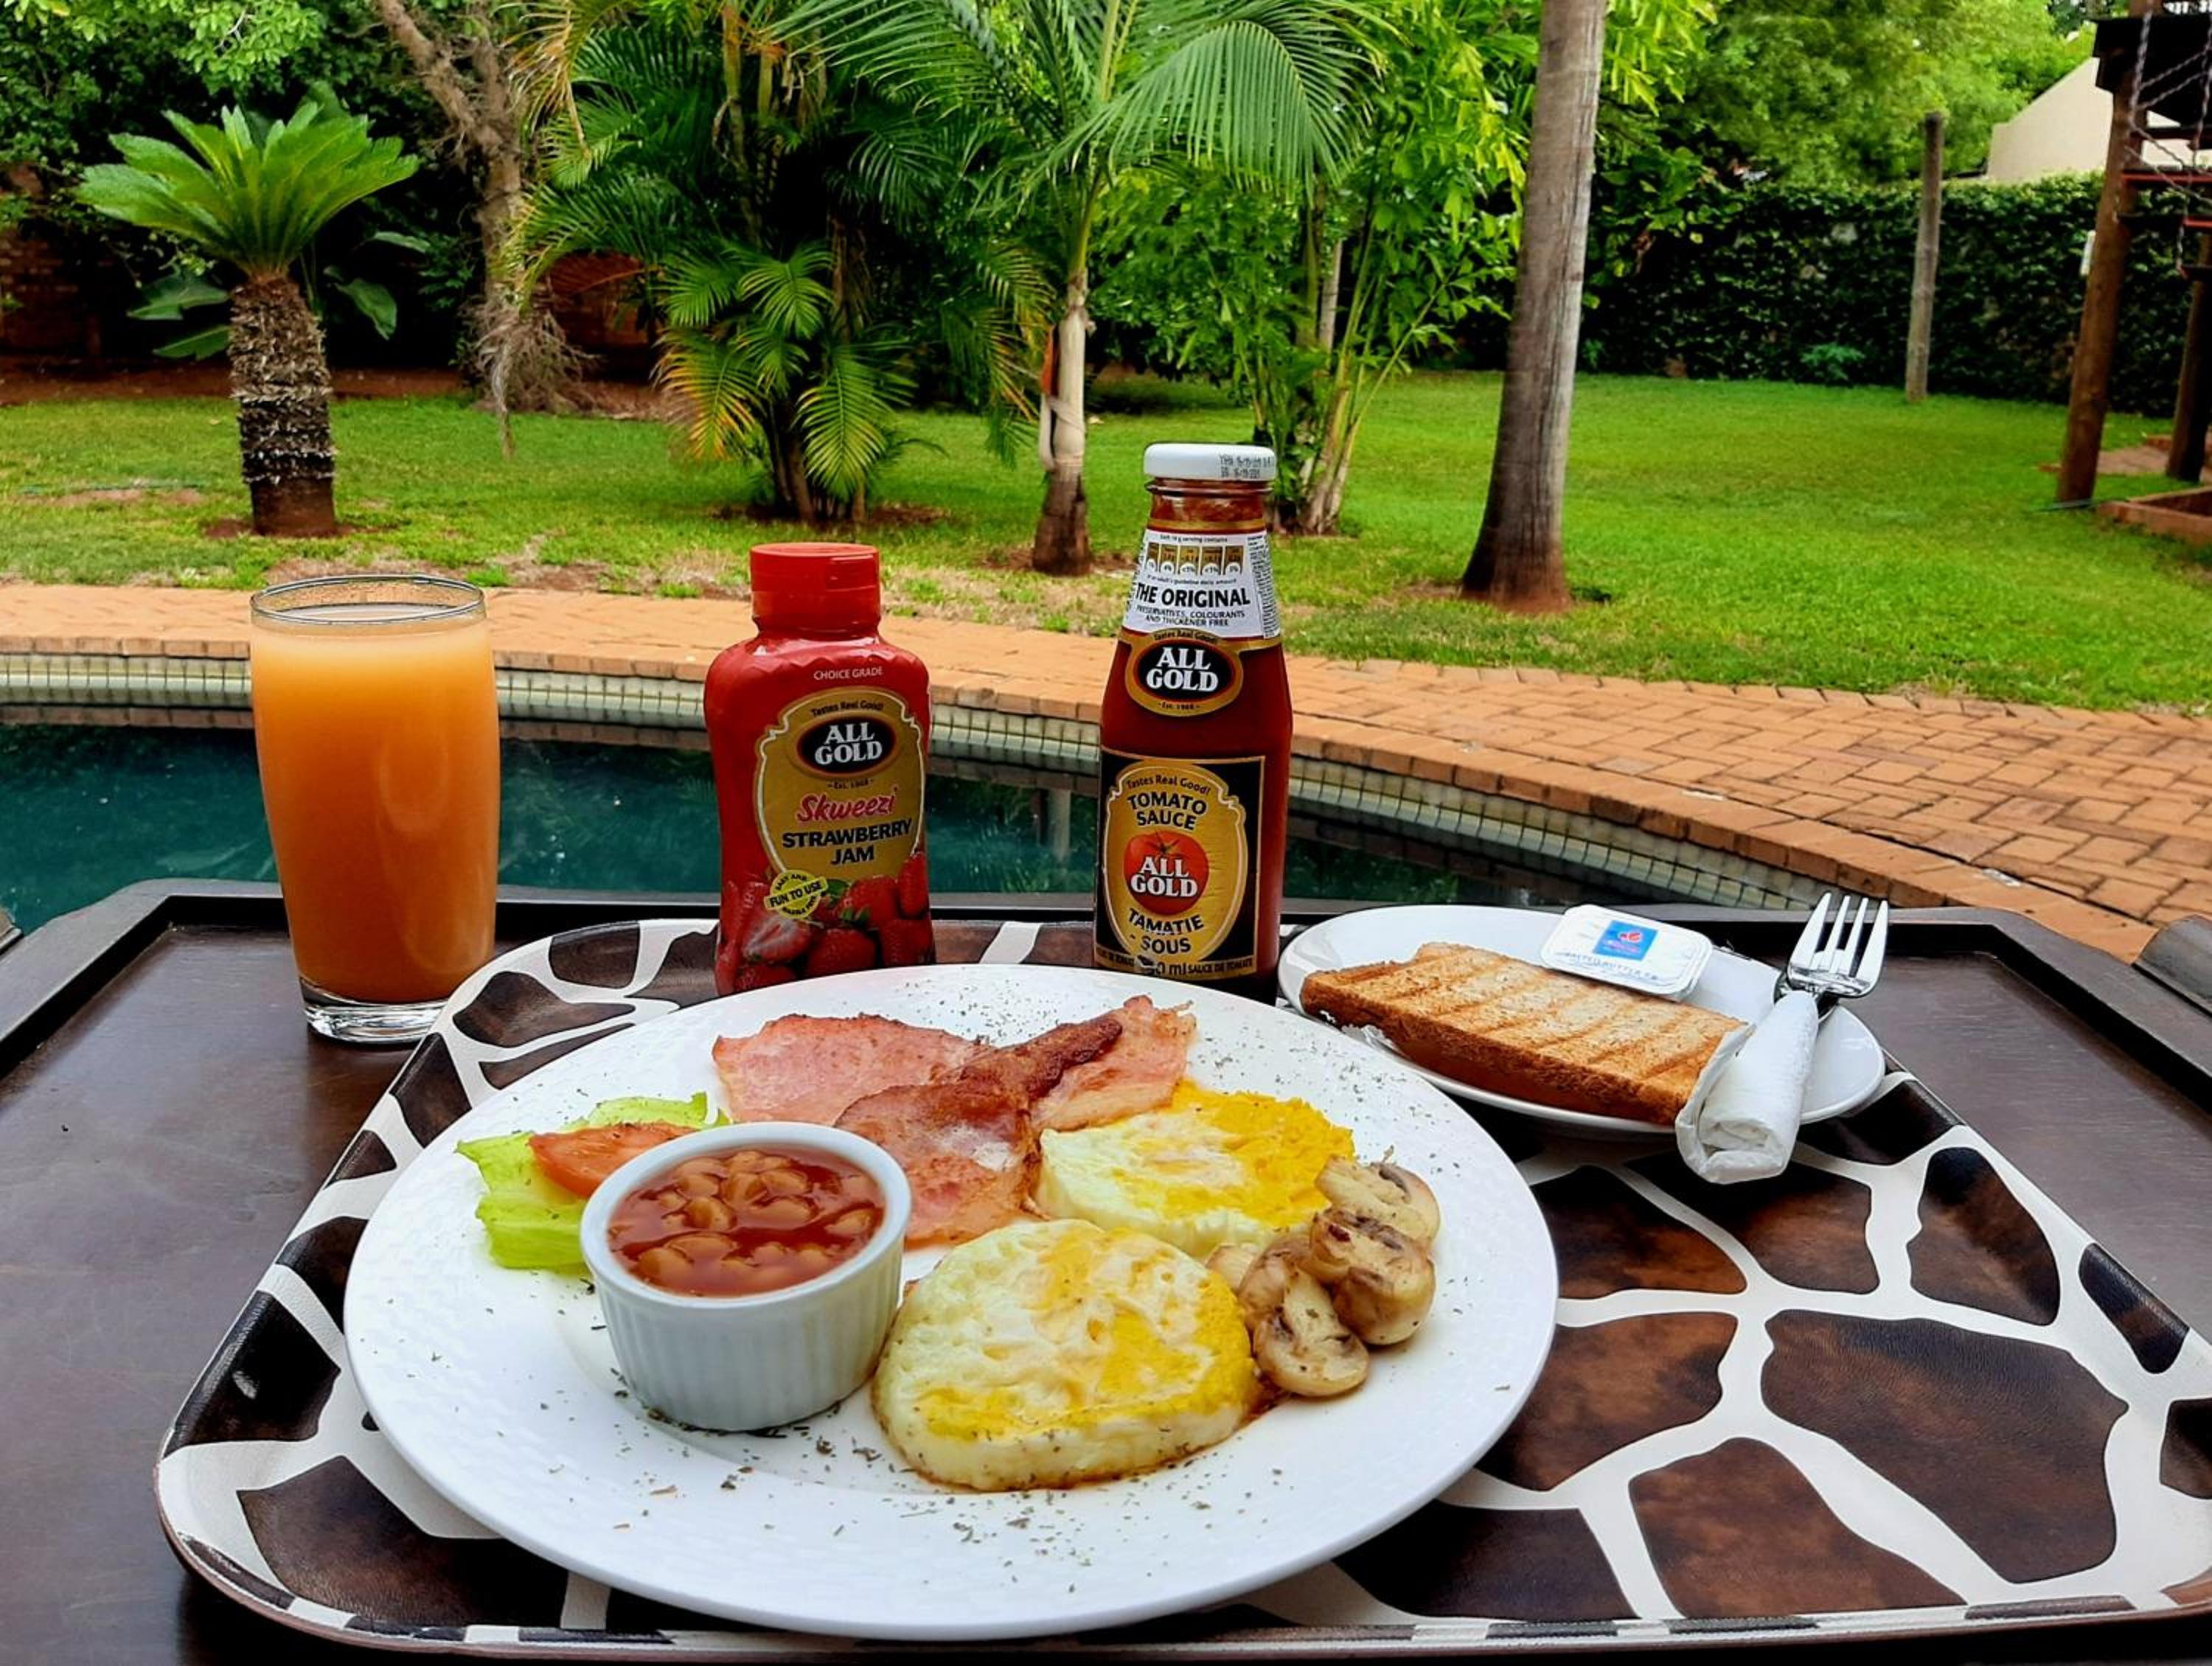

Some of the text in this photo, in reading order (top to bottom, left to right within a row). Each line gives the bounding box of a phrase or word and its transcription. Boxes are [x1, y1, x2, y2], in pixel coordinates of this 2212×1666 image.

[1135, 582, 1251, 608] THE ORIGINAL
[1162, 616, 1207, 626] THICKENER
[1189, 610, 1246, 619] COLOURANTS
[1155, 646, 1211, 670] ALL
[813, 666, 884, 680] CHOICE GRADE
[1146, 668, 1219, 692] GOLD
[824, 722, 876, 745] ALL
[814, 741, 883, 765] GOLD
[1127, 777, 1153, 789] Tastes
[1155, 775, 1178, 786] Real
[796, 786, 899, 823] Skweezi
[1127, 791, 1207, 815] TOMATO
[1136, 809, 1197, 831] SAUCE
[782, 818, 912, 848] STRAWBERRY
[830, 845, 875, 865] JAM
[1138, 856, 1190, 878] ALL
[769, 880, 822, 907] FUN TO USE
[1130, 874, 1198, 897] GOLD
[1127, 907, 1204, 934] TAMATIE
[1140, 935, 1192, 955] SOUS
